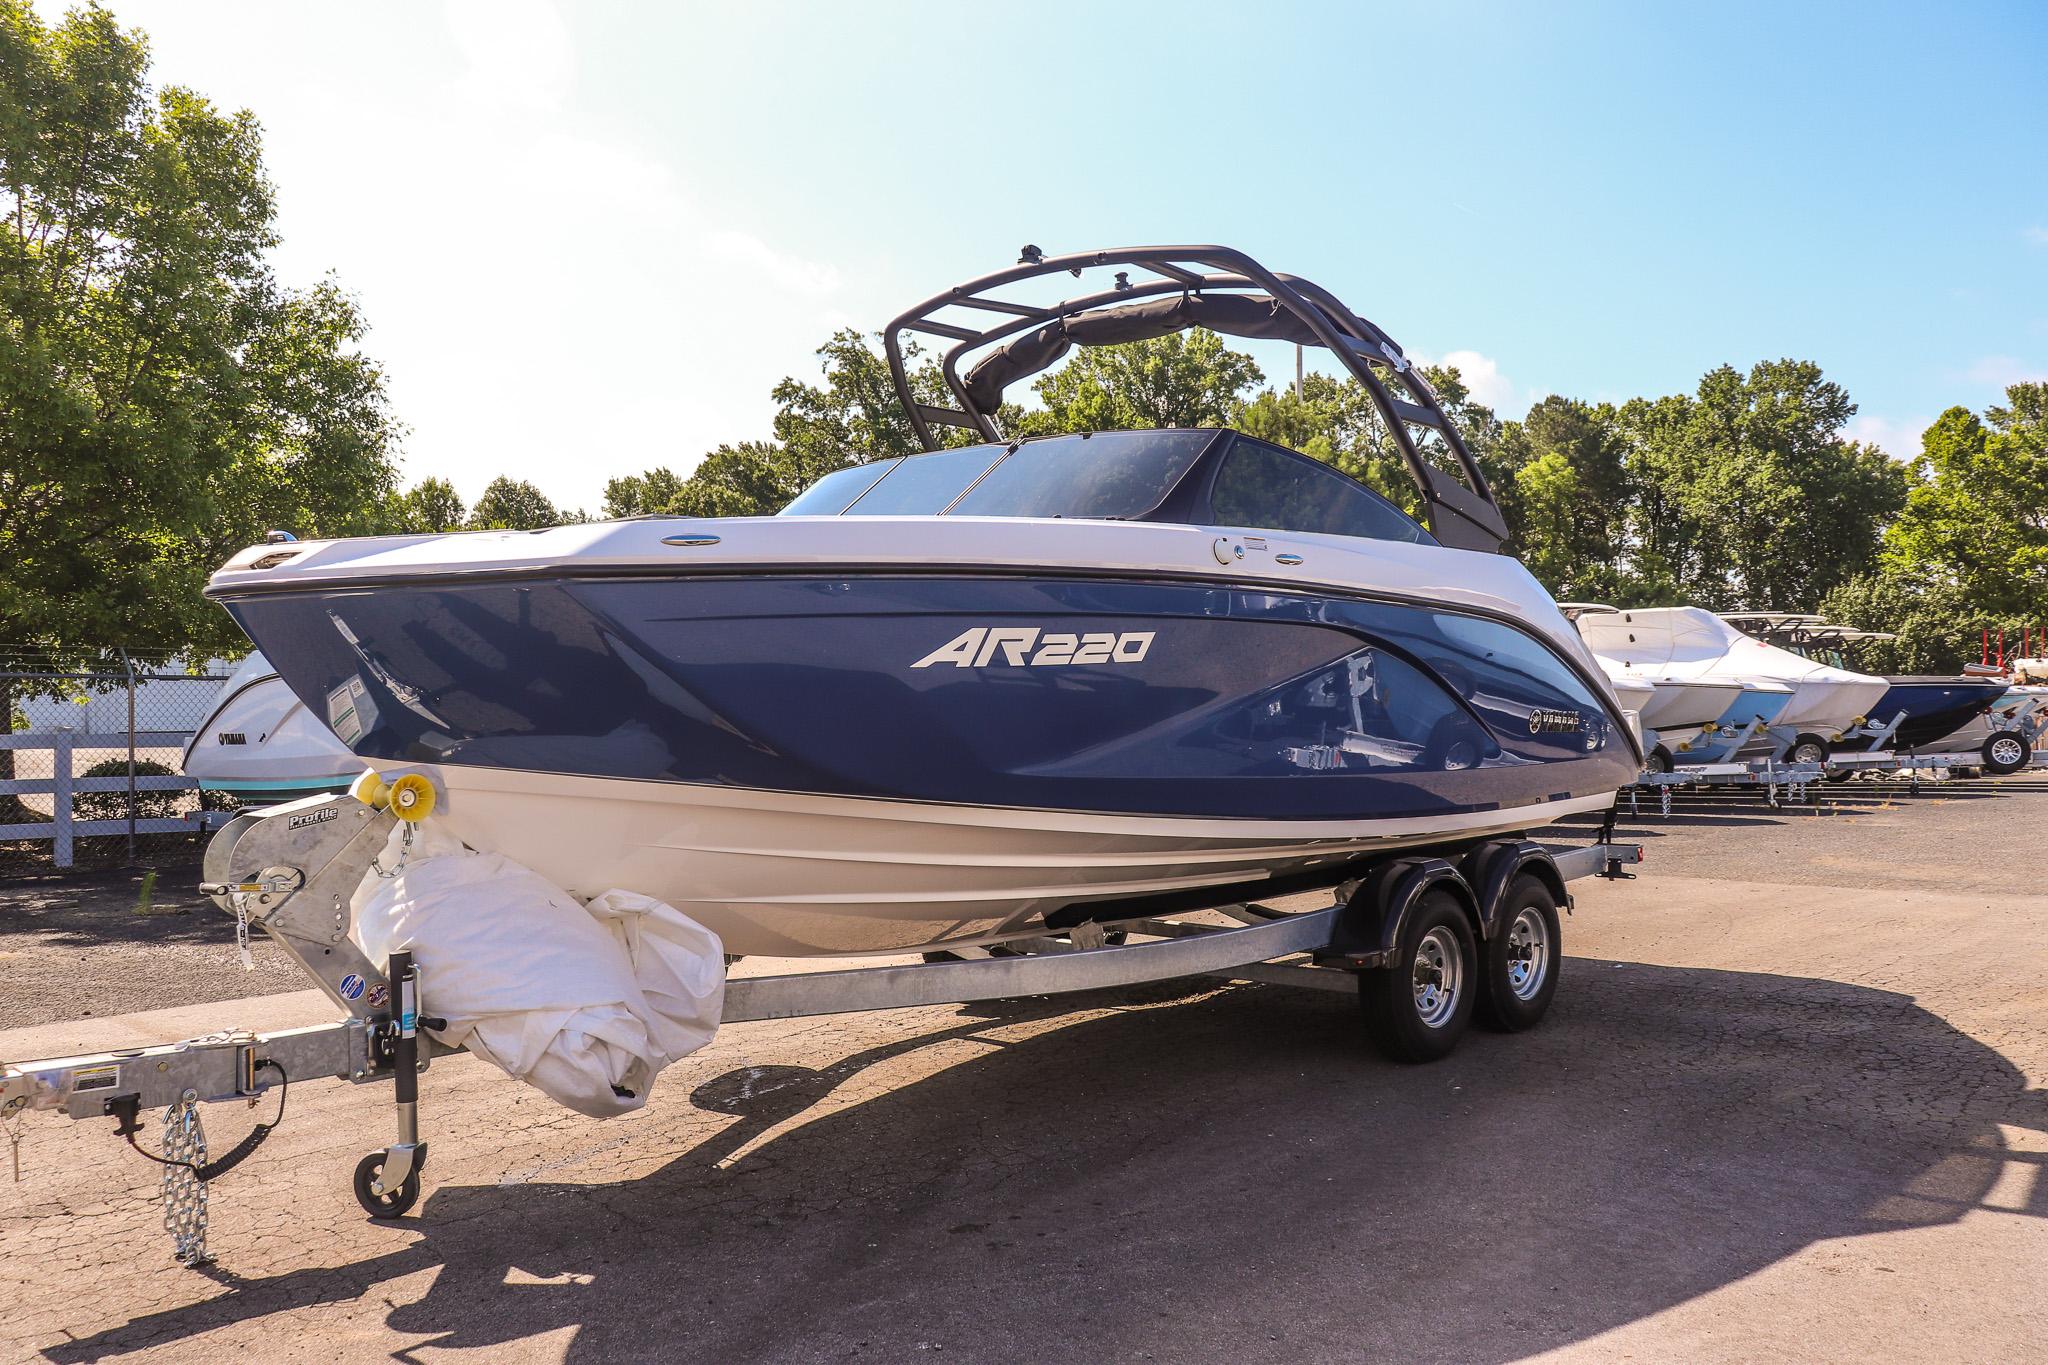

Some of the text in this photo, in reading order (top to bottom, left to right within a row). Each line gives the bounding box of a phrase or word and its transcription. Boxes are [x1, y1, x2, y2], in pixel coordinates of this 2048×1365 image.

[910, 627, 1156, 667] AR220
[224, 733, 247, 745] YAMAHA
[289, 808, 338, 827] Profile
